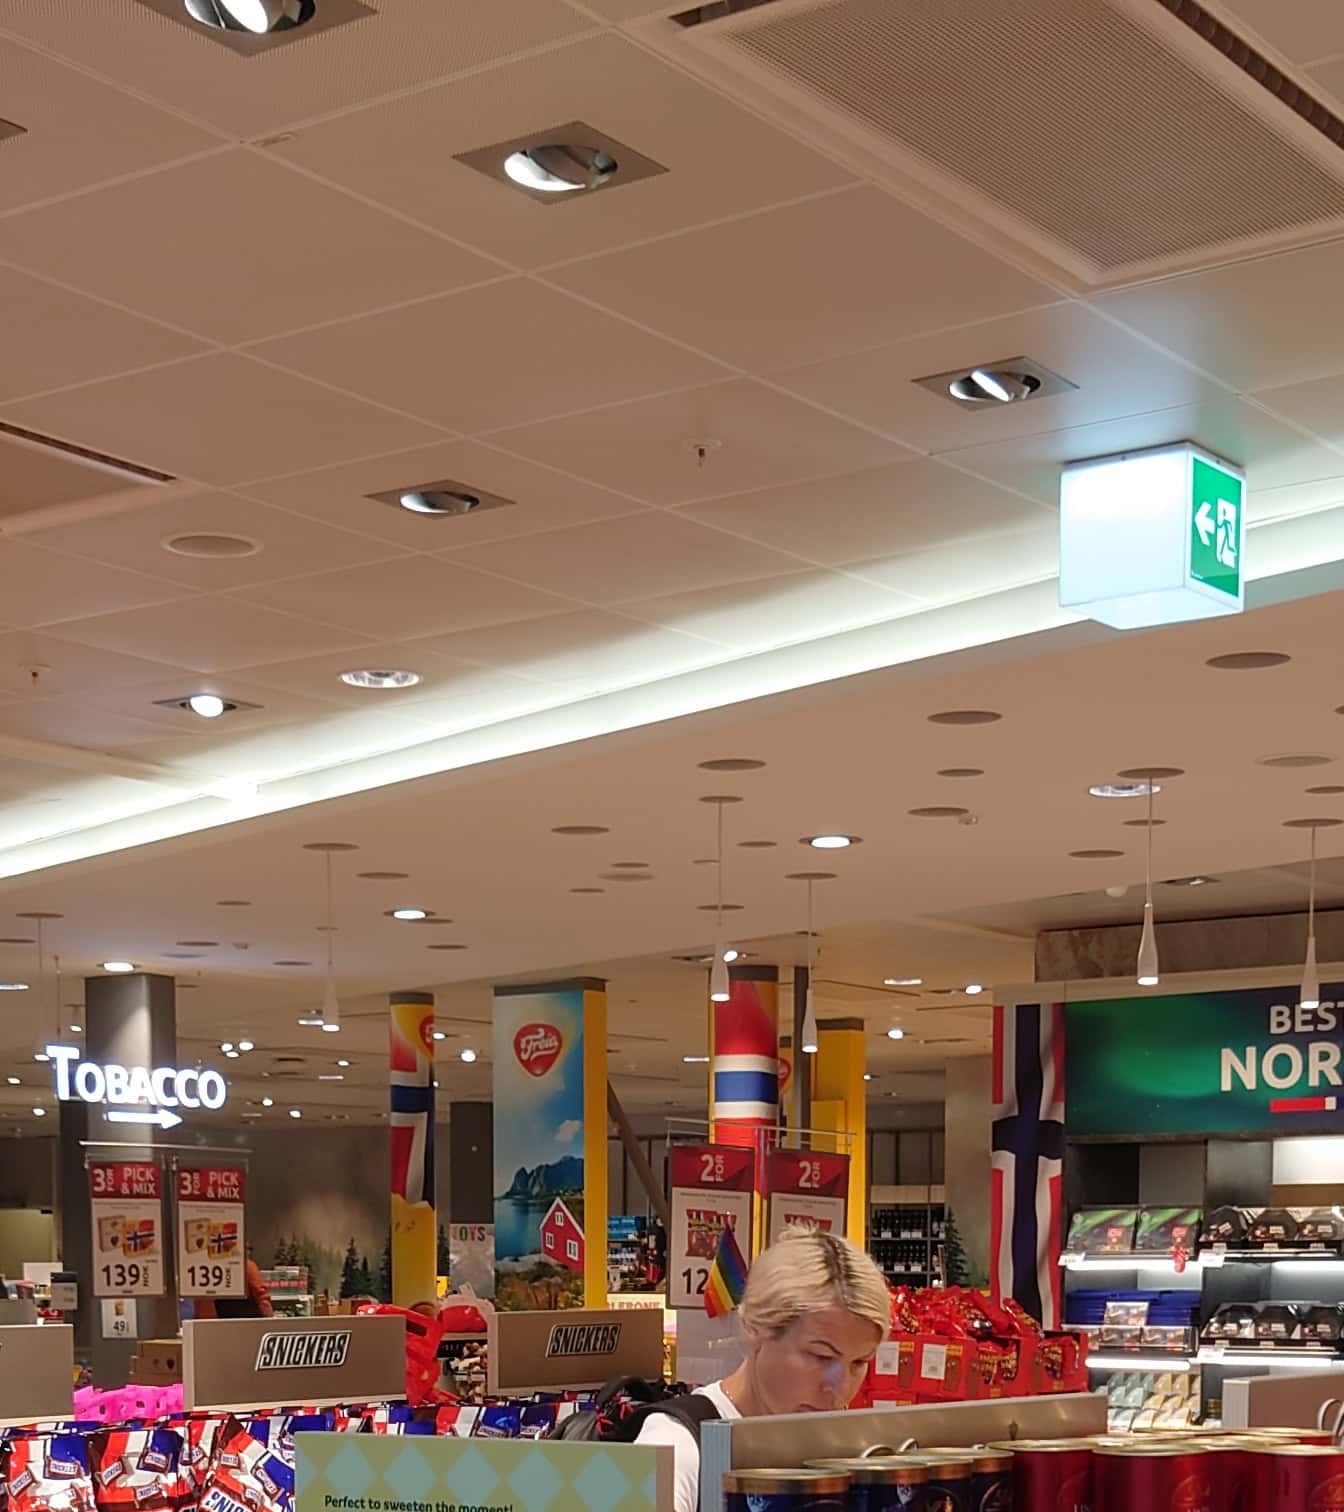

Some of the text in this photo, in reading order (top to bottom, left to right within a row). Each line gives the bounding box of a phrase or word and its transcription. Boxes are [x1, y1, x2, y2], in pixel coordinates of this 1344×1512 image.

[520, 1028, 558, 1060] Freia
[46, 1044, 226, 1108] TOBACCO
[123, 1168, 155, 1181] PICK
[209, 1171, 238, 1185] PICK
[701, 1154, 724, 1182] 2 FOR
[799, 1161, 812, 1188] 2
[94, 1169, 105, 1192] 3
[121, 1182, 155, 1194] & MIX
[181, 1172, 192, 1195] 3
[207, 1187, 239, 1199] & MIX
[102, 1264, 140, 1287] 139
[188, 1266, 222, 1287] 139
[114, 1321, 125, 1331] 49
[259, 1332, 350, 1367] SNICKERS
[549, 1325, 619, 1355] SNICKERS
[325, 1495, 365, 1509] Perfect
[369, 1500, 381, 1510] to
[384, 1500, 432, 1512] sweeten
